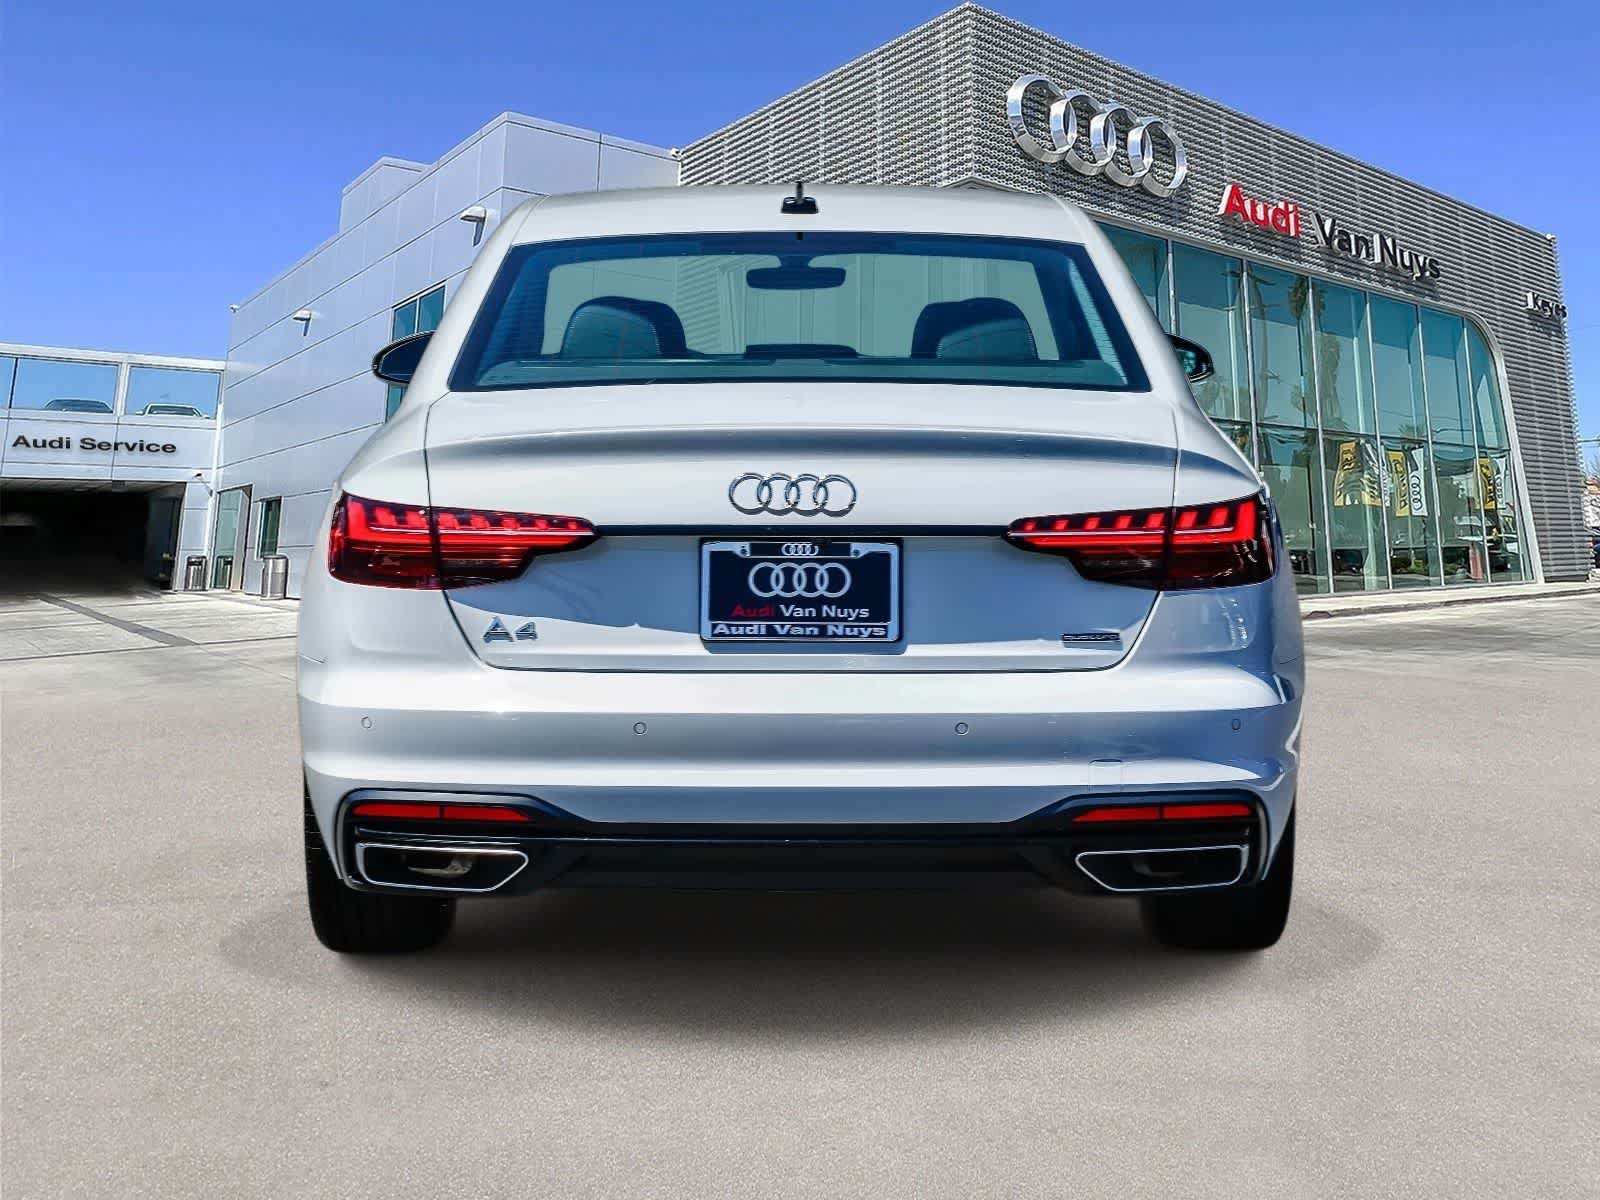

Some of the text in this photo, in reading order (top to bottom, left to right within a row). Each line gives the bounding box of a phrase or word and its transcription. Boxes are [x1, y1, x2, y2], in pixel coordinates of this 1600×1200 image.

[1217, 183, 1441, 280] Audi Van Nuys
[12, 435, 177, 453] Audi Service
[731, 603, 870, 620] Audi Van Nuys
[481, 616, 538, 643] A4
[713, 624, 887, 637] Audi Van Nuys
